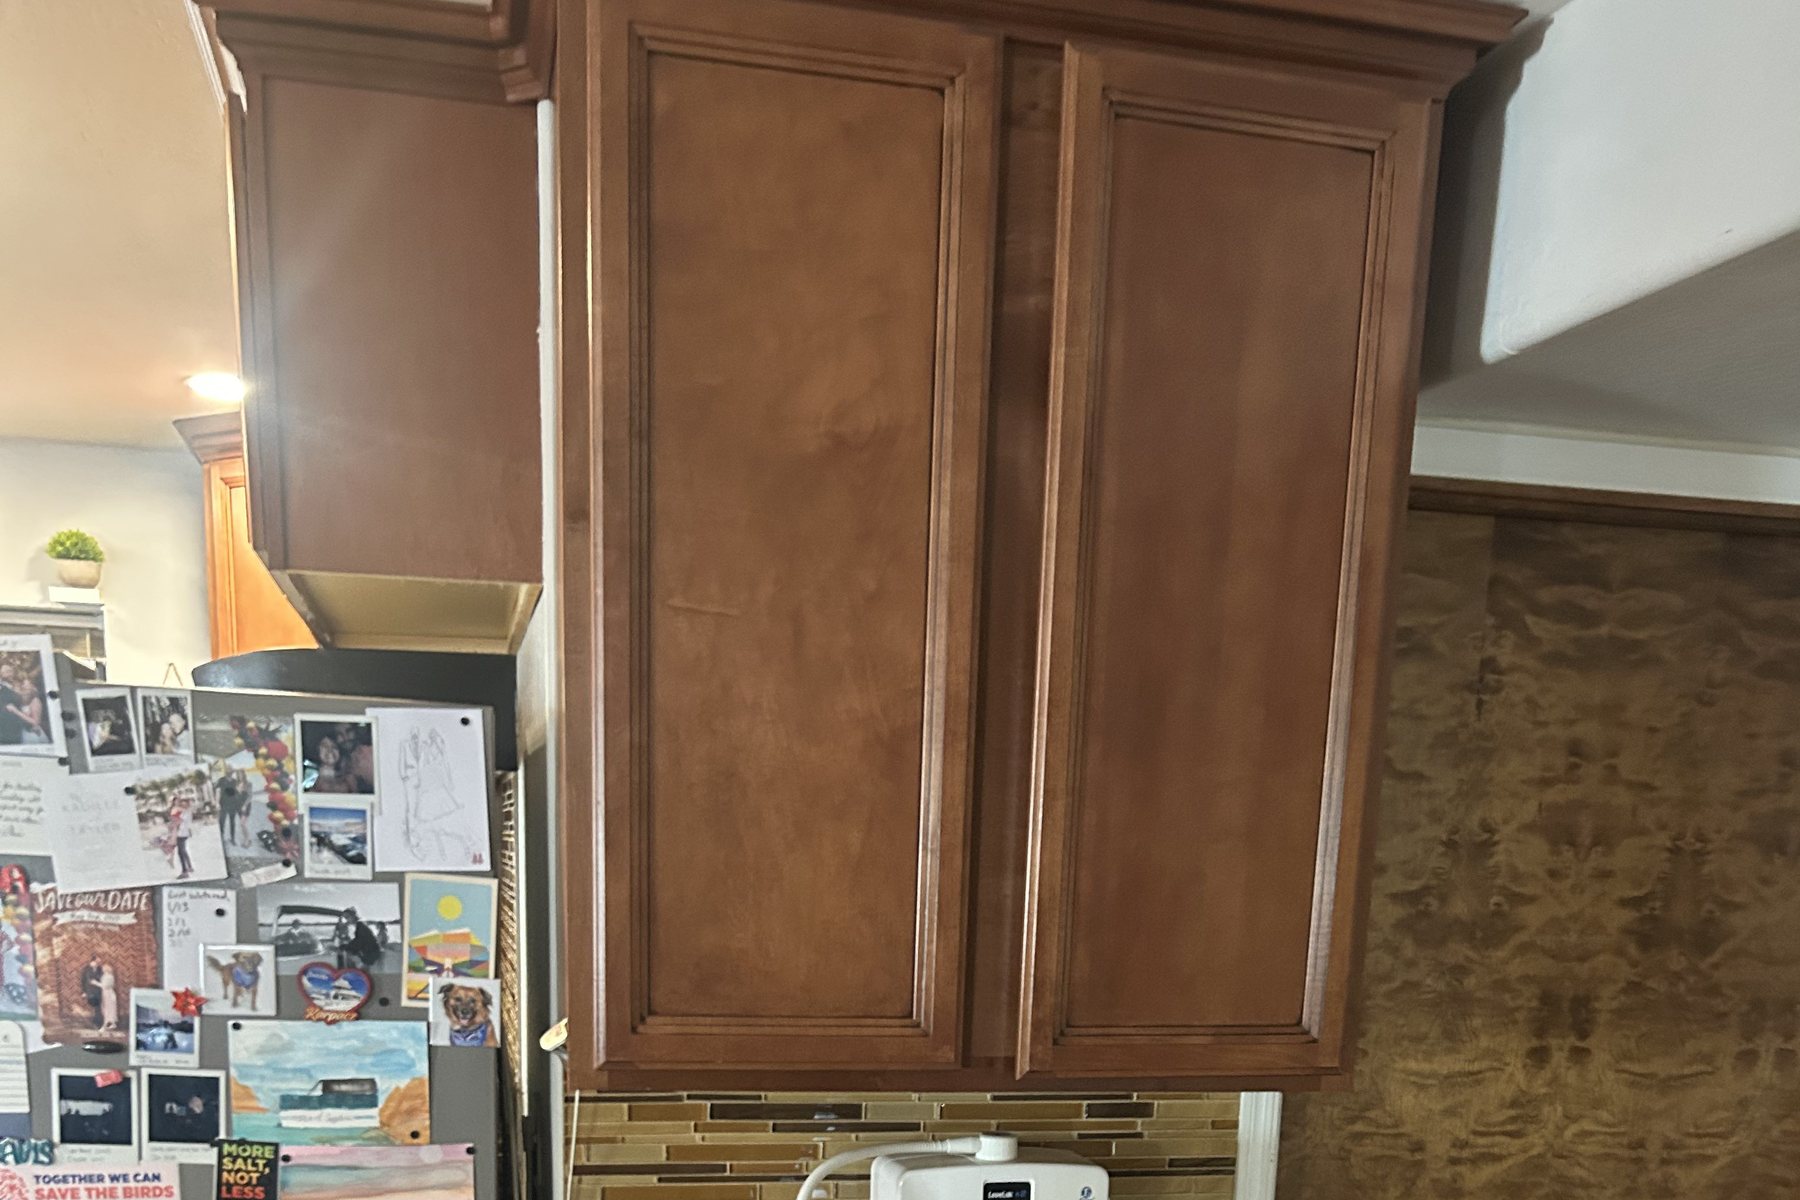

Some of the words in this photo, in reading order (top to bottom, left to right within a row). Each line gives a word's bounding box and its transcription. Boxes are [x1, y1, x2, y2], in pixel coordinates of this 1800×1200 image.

[107, 890, 151, 912] DATE
[222, 1143, 276, 1159] MORE
[222, 1158, 271, 1175] SALT,
[33, 1173, 106, 1185] TOGETHER
[108, 1173, 130, 1183] WE
[133, 1172, 162, 1183] CAN
[222, 1171, 261, 1185] NOT
[34, 1187, 82, 1200] SAVE
[84, 1186, 120, 1200] THE
[123, 1185, 175, 1199] BIRDS
[221, 1186, 266, 1200] LESS
